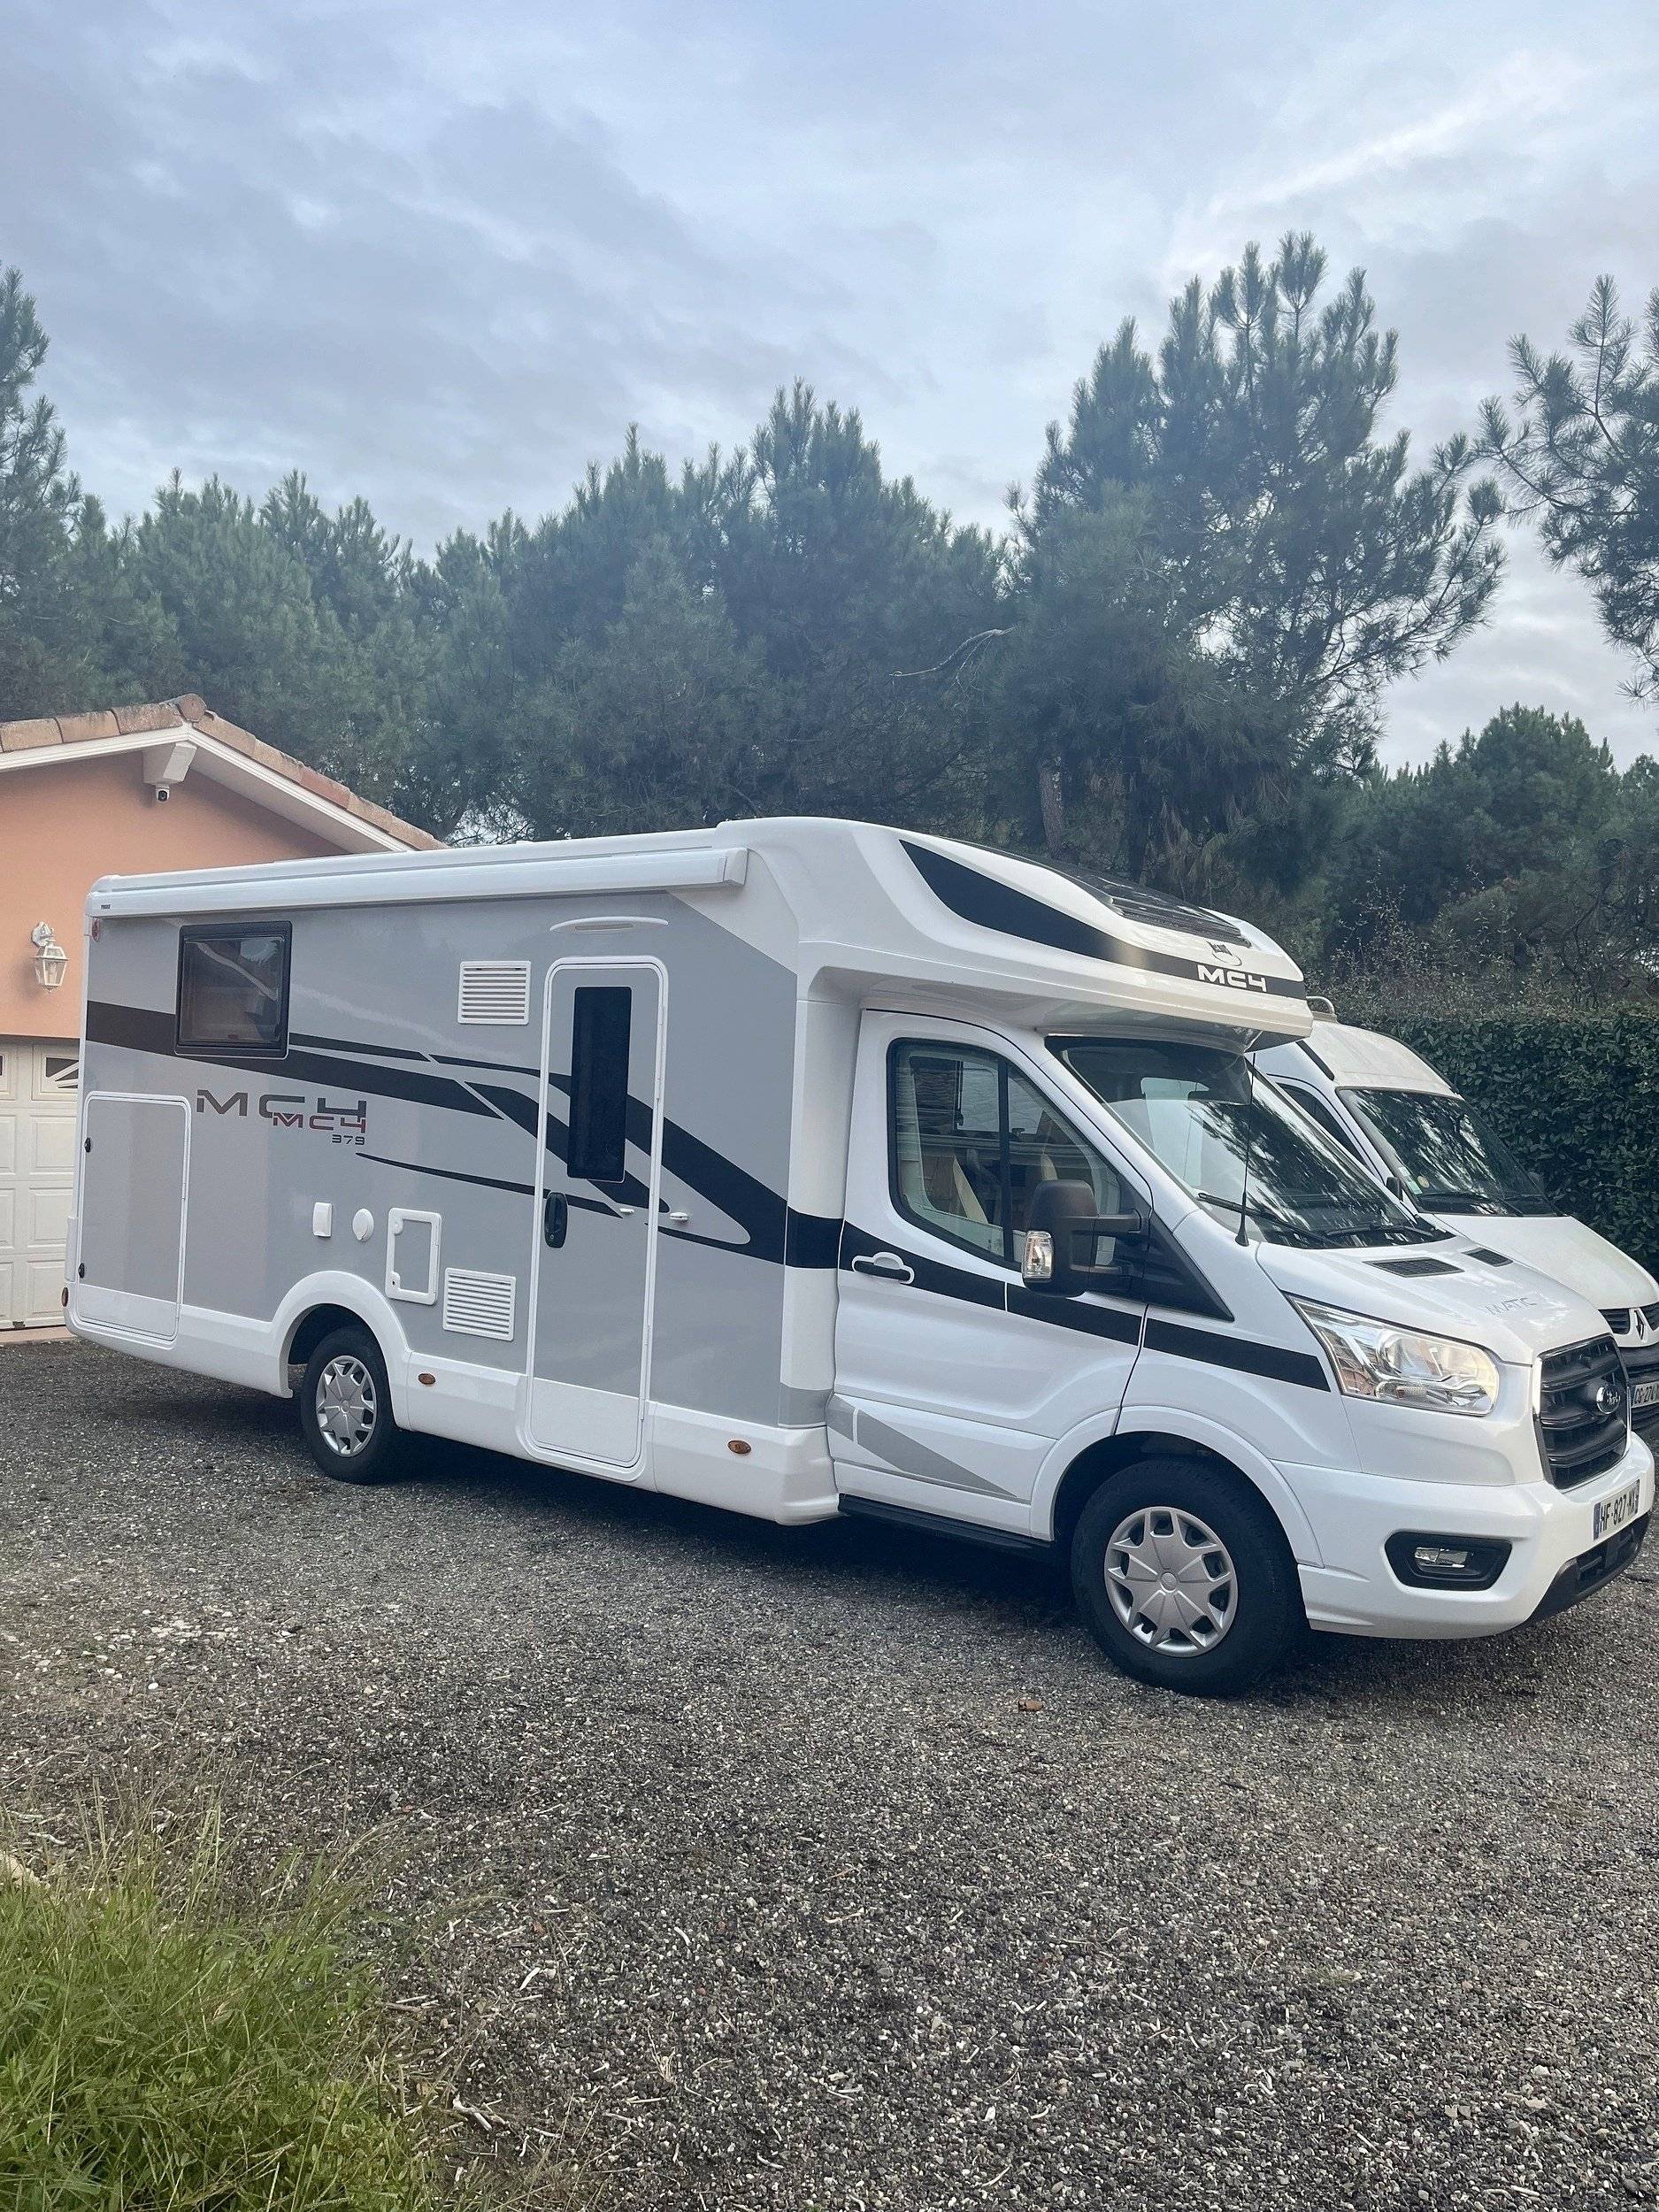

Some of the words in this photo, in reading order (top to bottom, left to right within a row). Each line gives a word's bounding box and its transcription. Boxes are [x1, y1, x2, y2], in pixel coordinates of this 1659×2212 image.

[1197, 964, 1267, 993] MC4
[196, 1089, 367, 1123] MC4
[273, 1112, 366, 1133] MC4
[332, 1134, 365, 1146] 379
